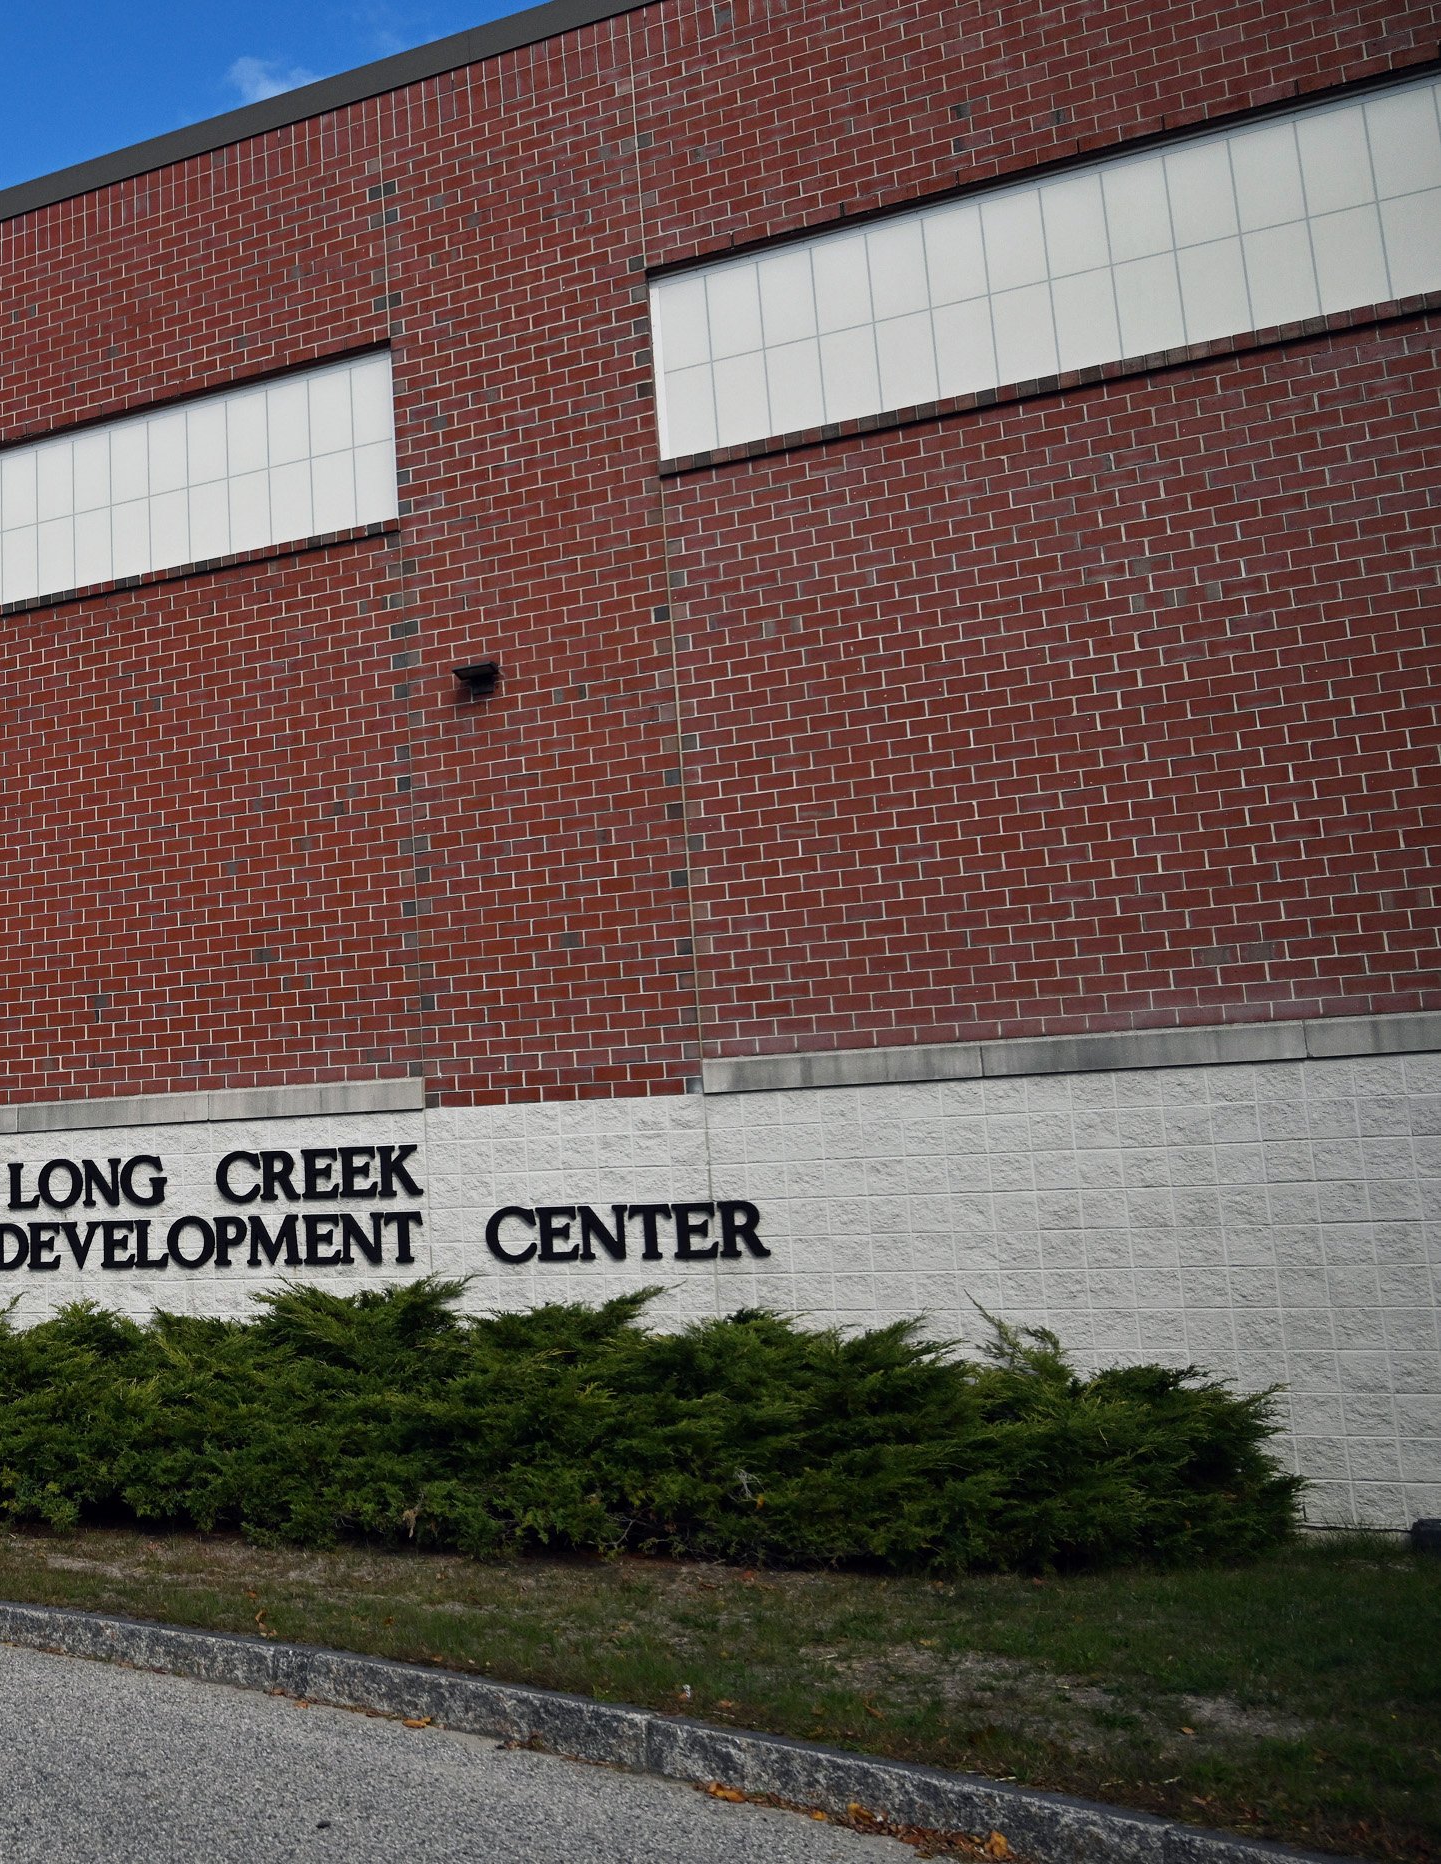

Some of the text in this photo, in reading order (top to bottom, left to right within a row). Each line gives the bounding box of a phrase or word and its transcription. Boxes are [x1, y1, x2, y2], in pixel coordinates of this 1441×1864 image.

[7, 1144, 424, 1212] LONG CREEK
[485, 1199, 772, 1266] CENTER
